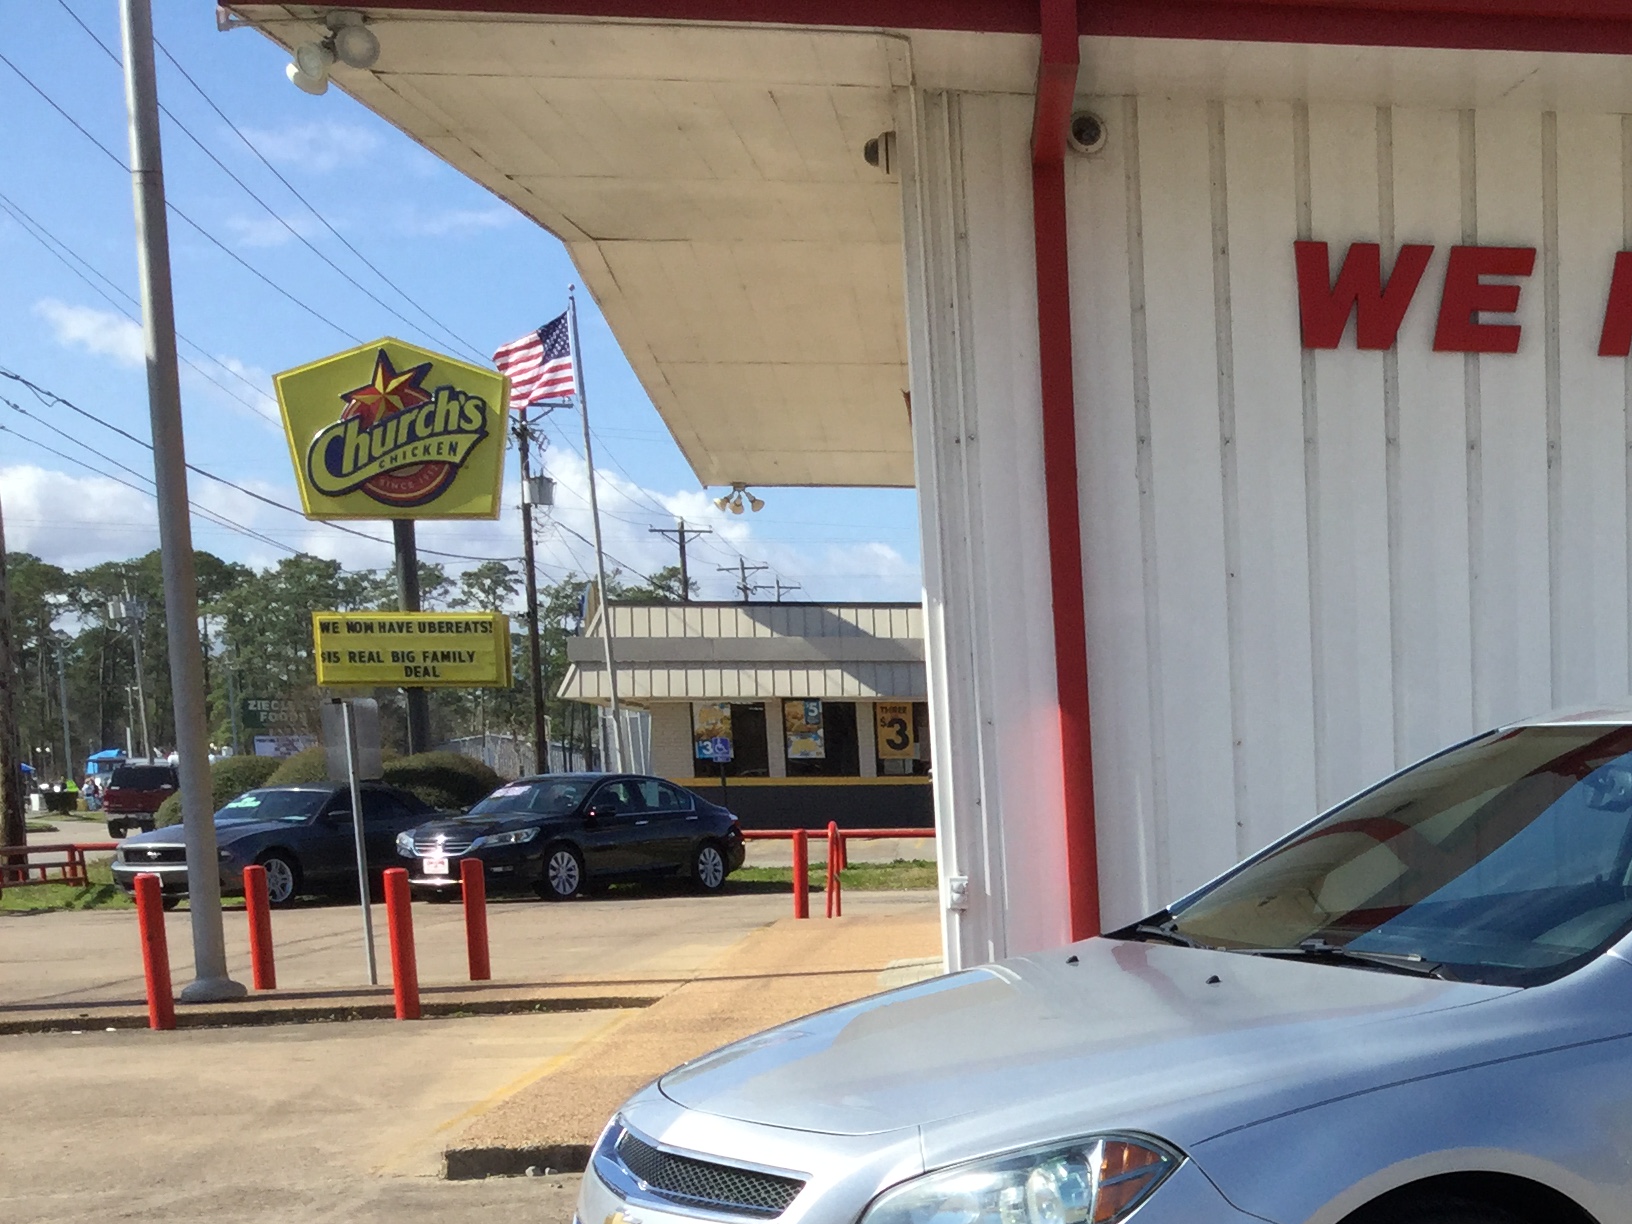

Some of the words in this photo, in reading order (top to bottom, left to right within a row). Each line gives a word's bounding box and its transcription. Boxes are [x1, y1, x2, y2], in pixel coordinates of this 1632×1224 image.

[1293, 240, 1536, 355] WE
[309, 388, 486, 492] Church's
[377, 440, 459, 470] CHICKEN
[378, 477, 415, 491] SINCE
[320, 621, 341, 634] WE
[378, 621, 414, 634] HAVE
[417, 621, 493, 634] UBEREATS!
[348, 650, 385, 664] REAL
[391, 650, 416, 664] BIG
[422, 650, 476, 664] FAMILY
[404, 665, 440, 678] DEAL
[880, 716, 910, 751] $3
